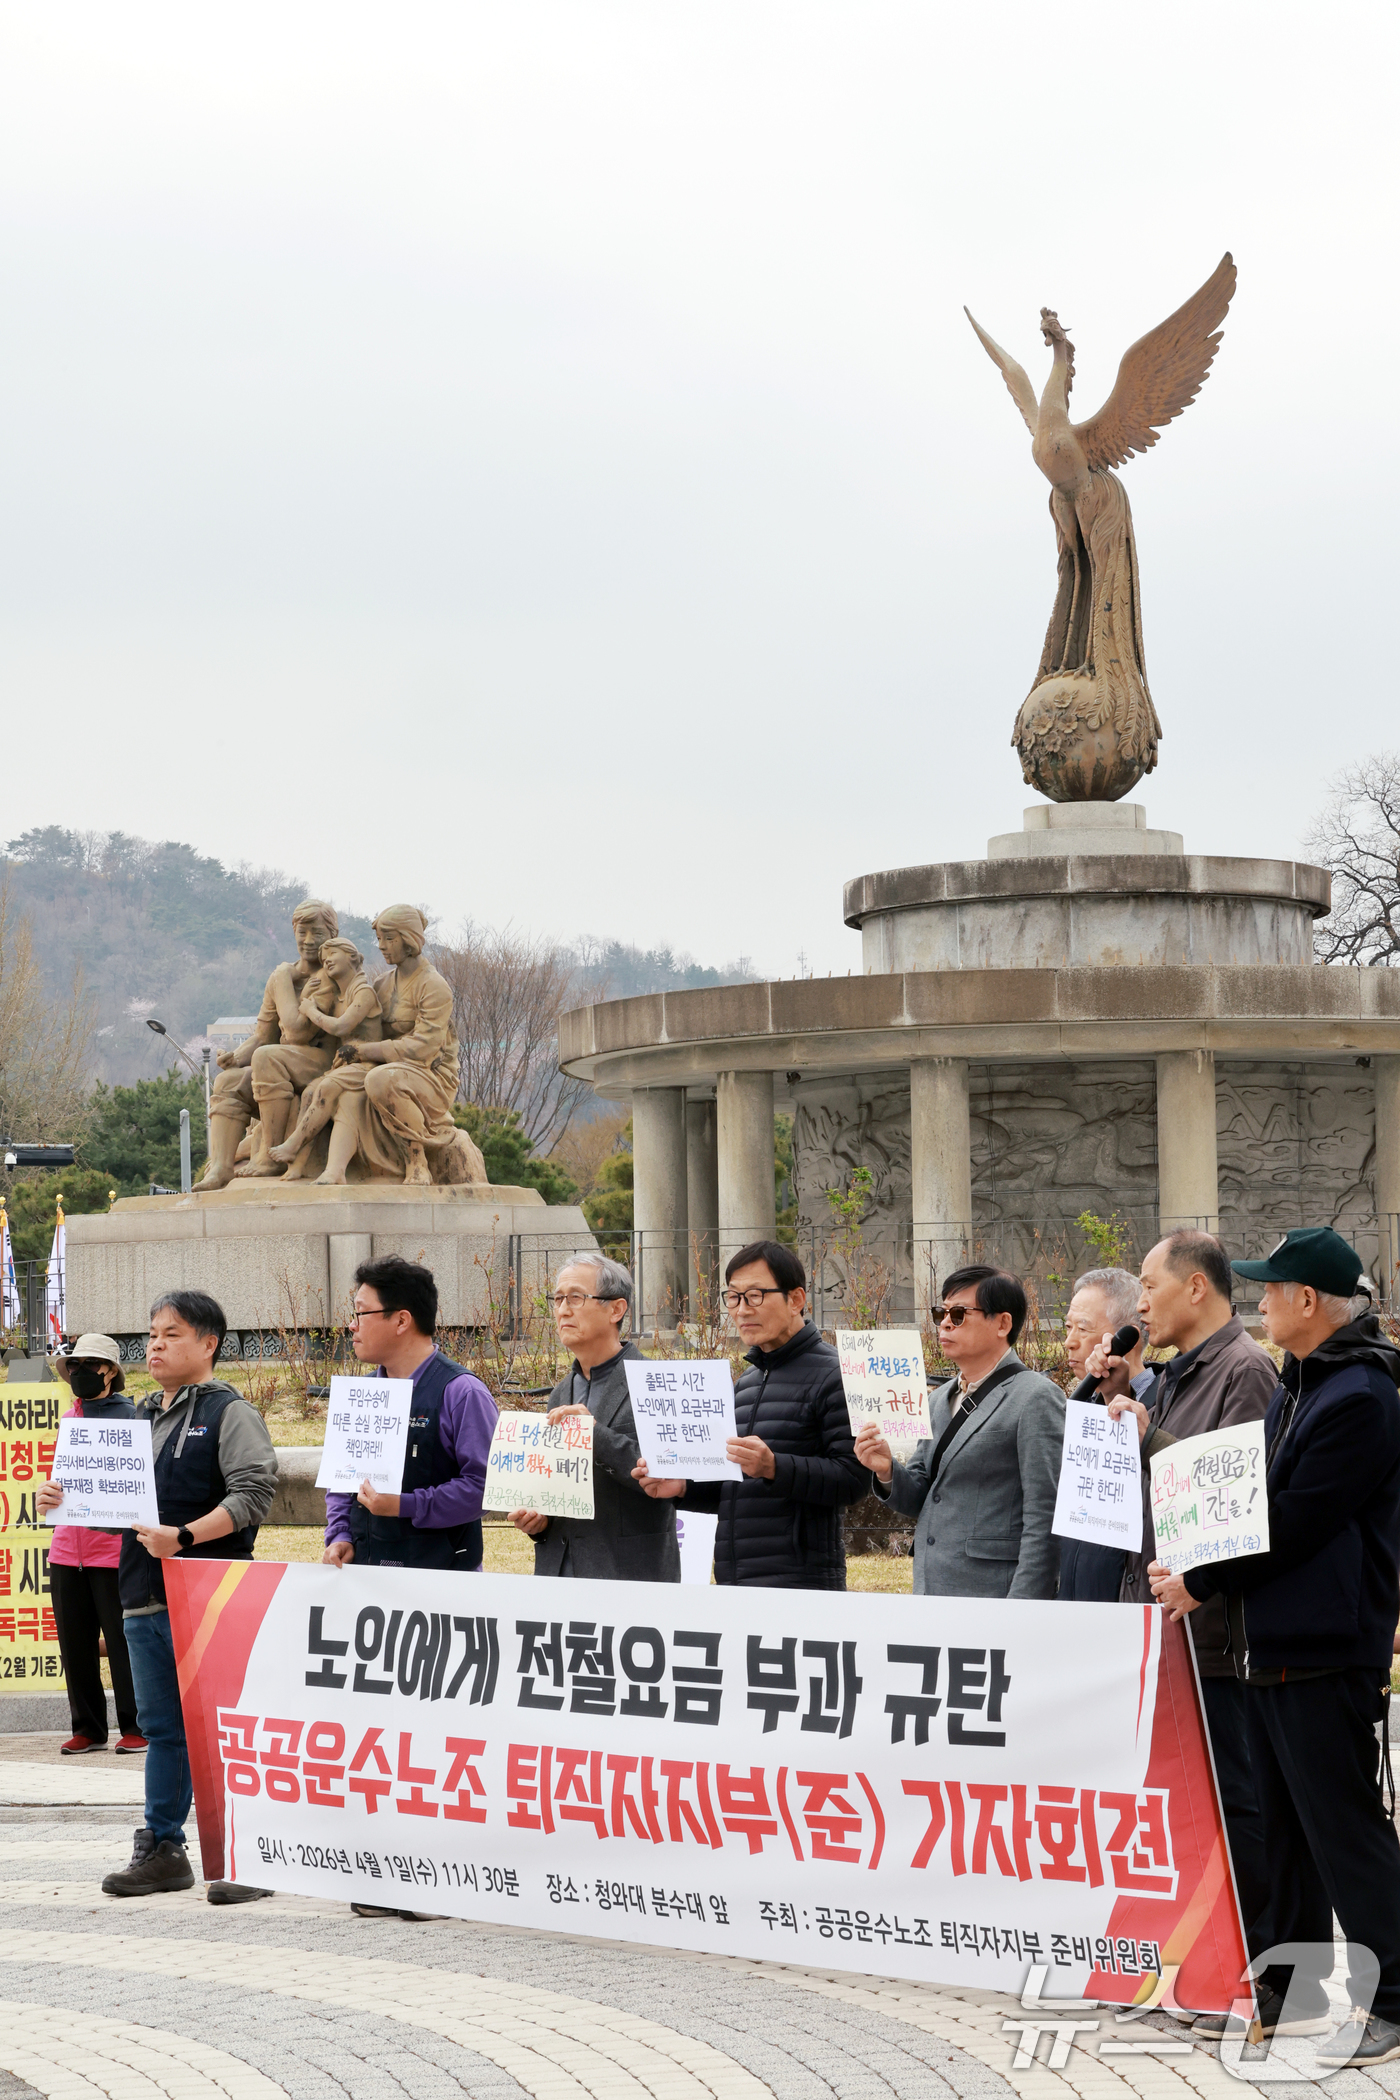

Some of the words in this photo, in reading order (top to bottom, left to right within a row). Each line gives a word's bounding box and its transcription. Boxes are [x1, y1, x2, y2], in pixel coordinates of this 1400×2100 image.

[857, 1333, 875, 1352] 이상
[868, 1356, 919, 1378] 전철요금?
[646, 1372, 677, 1392] 출퇴근
[682, 1372, 705, 1392] 시간
[348, 1389, 390, 1409] 무임수송에
[637, 1398, 677, 1417] 노인에게
[681, 1399, 725, 1417] 요금부과
[864, 1397, 883, 1413] 정부
[885, 1389, 924, 1416] 규탄!
[333, 1413, 351, 1432] 따른
[355, 1415, 370, 1433] 손실
[374, 1416, 401, 1435] 정부가
[657, 1424, 677, 1442] 규탄
[681, 1424, 711, 1442] 한다!!
[1082, 1416, 1106, 1442] 출퇴근
[1109, 1421, 1128, 1446] 시간
[70, 1428, 92, 1446] 철도,
[98, 1429, 133, 1448] 지하철
[495, 1420, 517, 1443] 노인
[564, 1428, 592, 1451] 42년
[346, 1438, 383, 1459] 책임져라!!
[0, 1440, 57, 1482] 청부
[55, 1455, 145, 1472] 공익서비스비용(PSO)
[490, 1450, 525, 1473] 이재명
[1067, 1443, 1100, 1470] 노인에게
[1102, 1451, 1138, 1478] 요금부과
[98, 1479, 146, 1496] 확보하라!!
[1077, 1475, 1094, 1499] 규탄
[1097, 1479, 1125, 1503] 한다!!
[31, 1654, 64, 1678] 기준)
[304, 1605, 500, 1707] 노인에게
[515, 1619, 723, 1727] 전철요금
[746, 1634, 864, 1740] 부과
[884, 1643, 1012, 1748] 규탄
[219, 1711, 487, 1825] 공공운수노조
[506, 1742, 886, 1871] 퇴직자지부(준)
[900, 1778, 1173, 1894] 기자회견
[257, 1836, 288, 1867] 일시
[297, 1843, 353, 1874] 2026년
[356, 1851, 383, 1878] 4월
[384, 1854, 438, 1887] 1일(수)
[442, 1862, 479, 1892] 11시
[482, 1866, 520, 1897] 30분
[546, 1873, 580, 1904] 장소
[595, 1878, 647, 1915] 청와대
[651, 1886, 706, 1922] 분수대
[709, 1894, 730, 1925] 앞
[758, 1900, 799, 1934] 주최
[815, 1906, 933, 1948] 공공운수노조
[940, 1920, 1044, 1964] 퇴직자지부
[1051, 1932, 1163, 1976] 준비위원회
